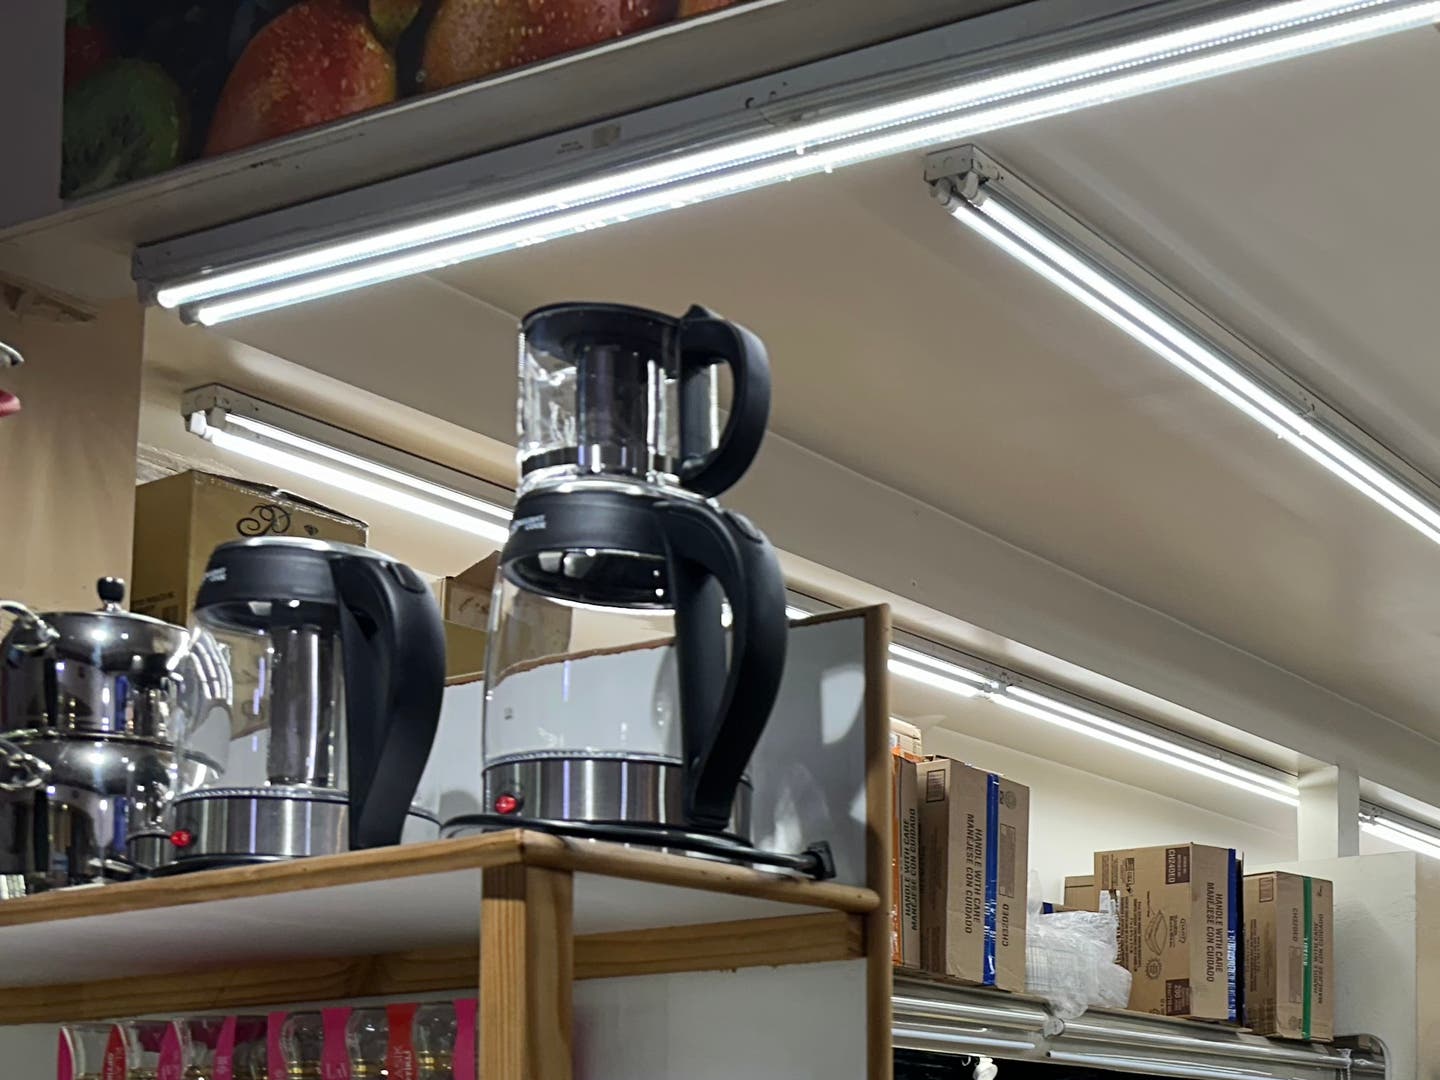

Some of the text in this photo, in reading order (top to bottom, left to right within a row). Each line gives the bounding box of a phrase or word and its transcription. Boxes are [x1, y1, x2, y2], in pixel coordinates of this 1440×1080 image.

[964, 813, 975, 934] MANEJESE CON CUIDADO
[974, 828, 983, 923] HANDLE WITH CARE
[1206, 882, 1215, 982] MANEJESE CON CUIDADO
[1214, 893, 1223, 972] HANDLE WITH CARE
